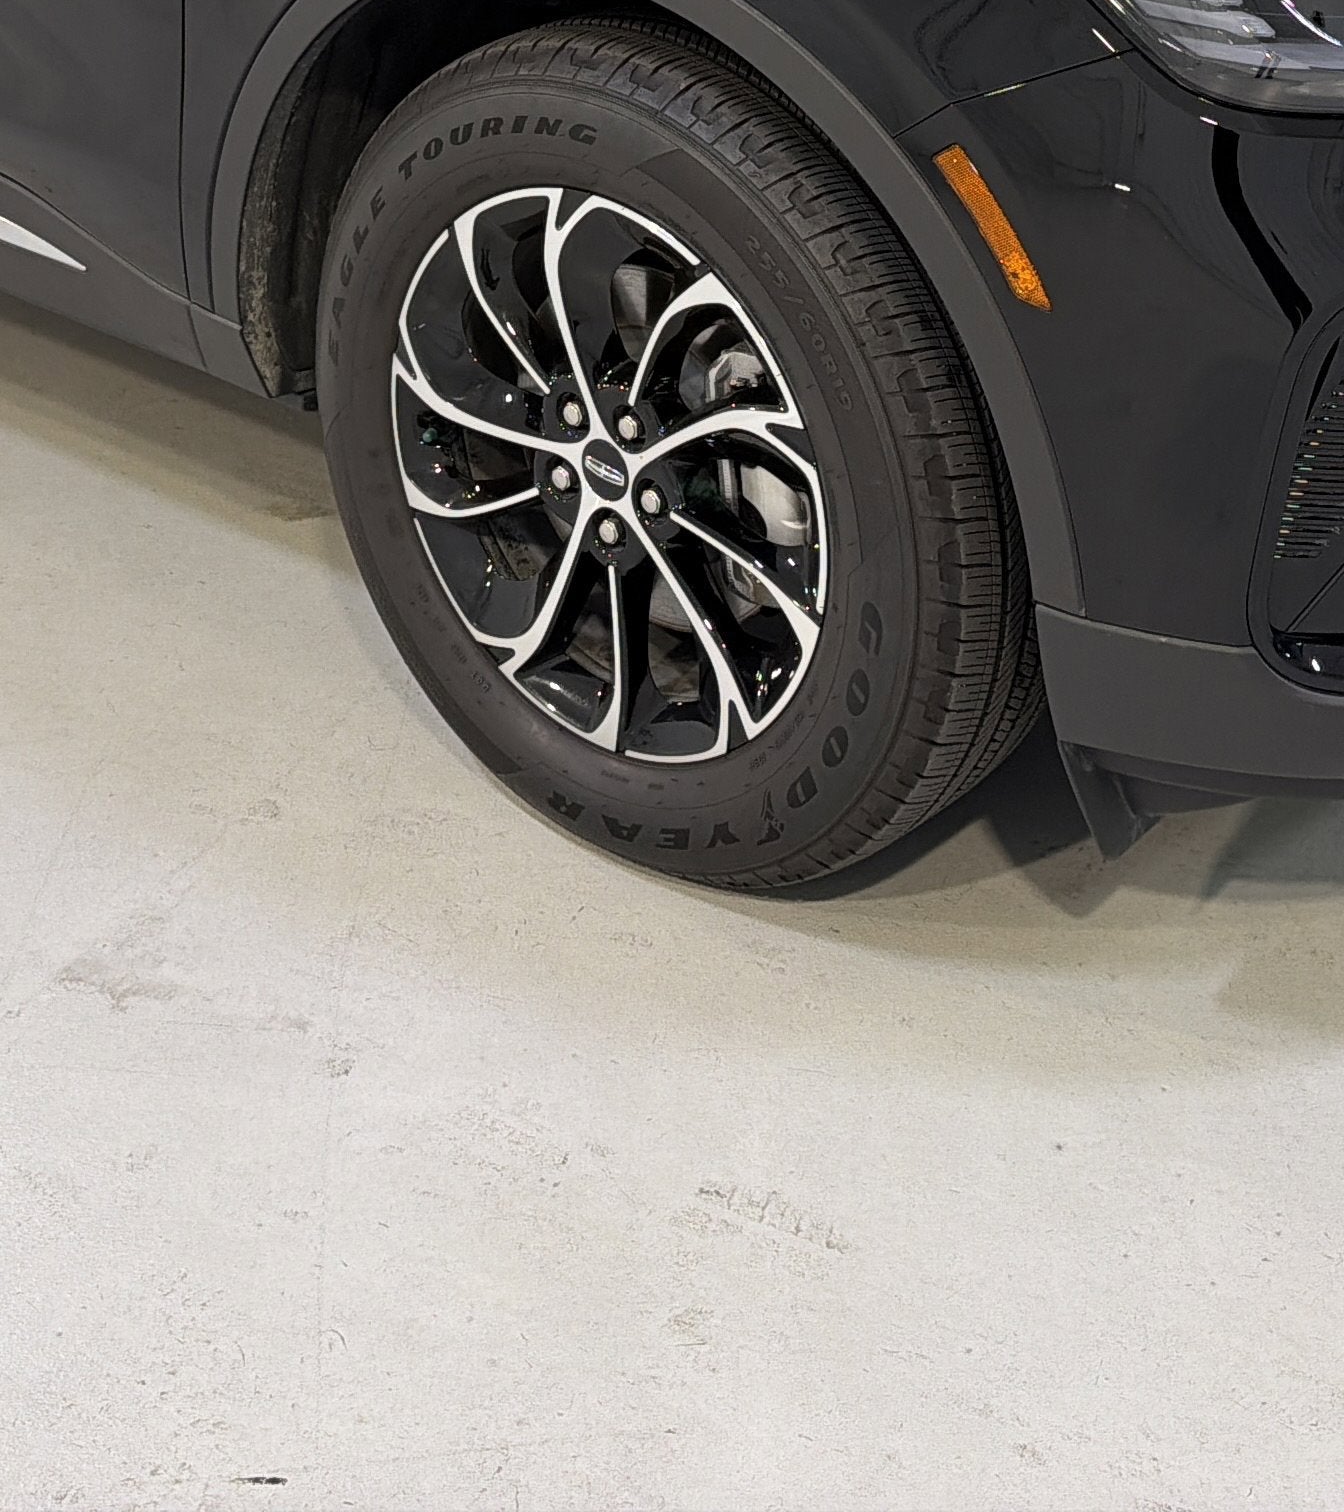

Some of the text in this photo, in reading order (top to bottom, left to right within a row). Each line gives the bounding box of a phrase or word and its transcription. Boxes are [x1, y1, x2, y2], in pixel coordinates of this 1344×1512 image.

[327, 114, 598, 367] EAGLE TOURING
[545, 601, 883, 850] GOODYEAR
